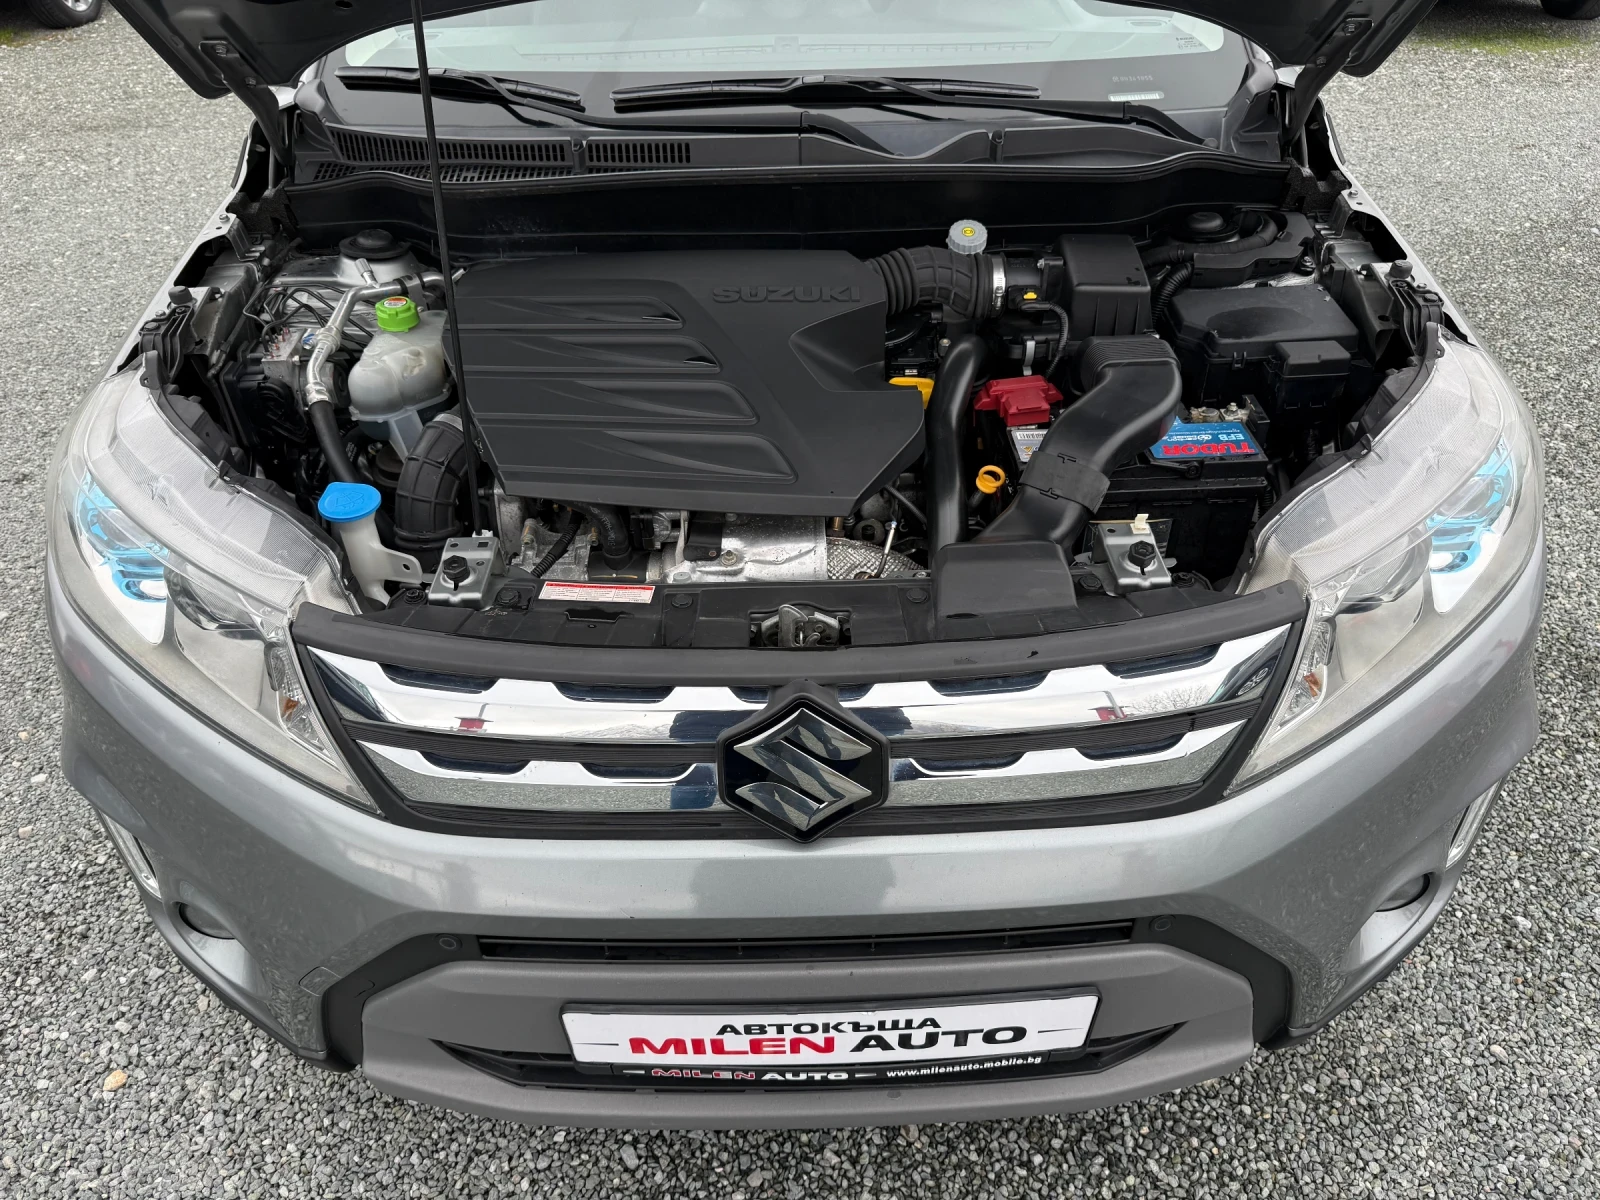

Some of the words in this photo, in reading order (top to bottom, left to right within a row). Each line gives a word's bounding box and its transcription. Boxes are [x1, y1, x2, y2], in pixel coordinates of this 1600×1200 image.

[713, 286, 860, 303] SUZUKI
[1218, 433, 1245, 441] EFB
[1162, 442, 1256, 455] TUDOR
[629, 1036, 835, 1055] MILEN
[849, 1026, 1028, 1053] AUTO
[651, 1068, 756, 1080] MILEN
[761, 1070, 849, 1081] AUTO
[886, 1055, 1042, 1078] www.milenauto.mobile.bg
